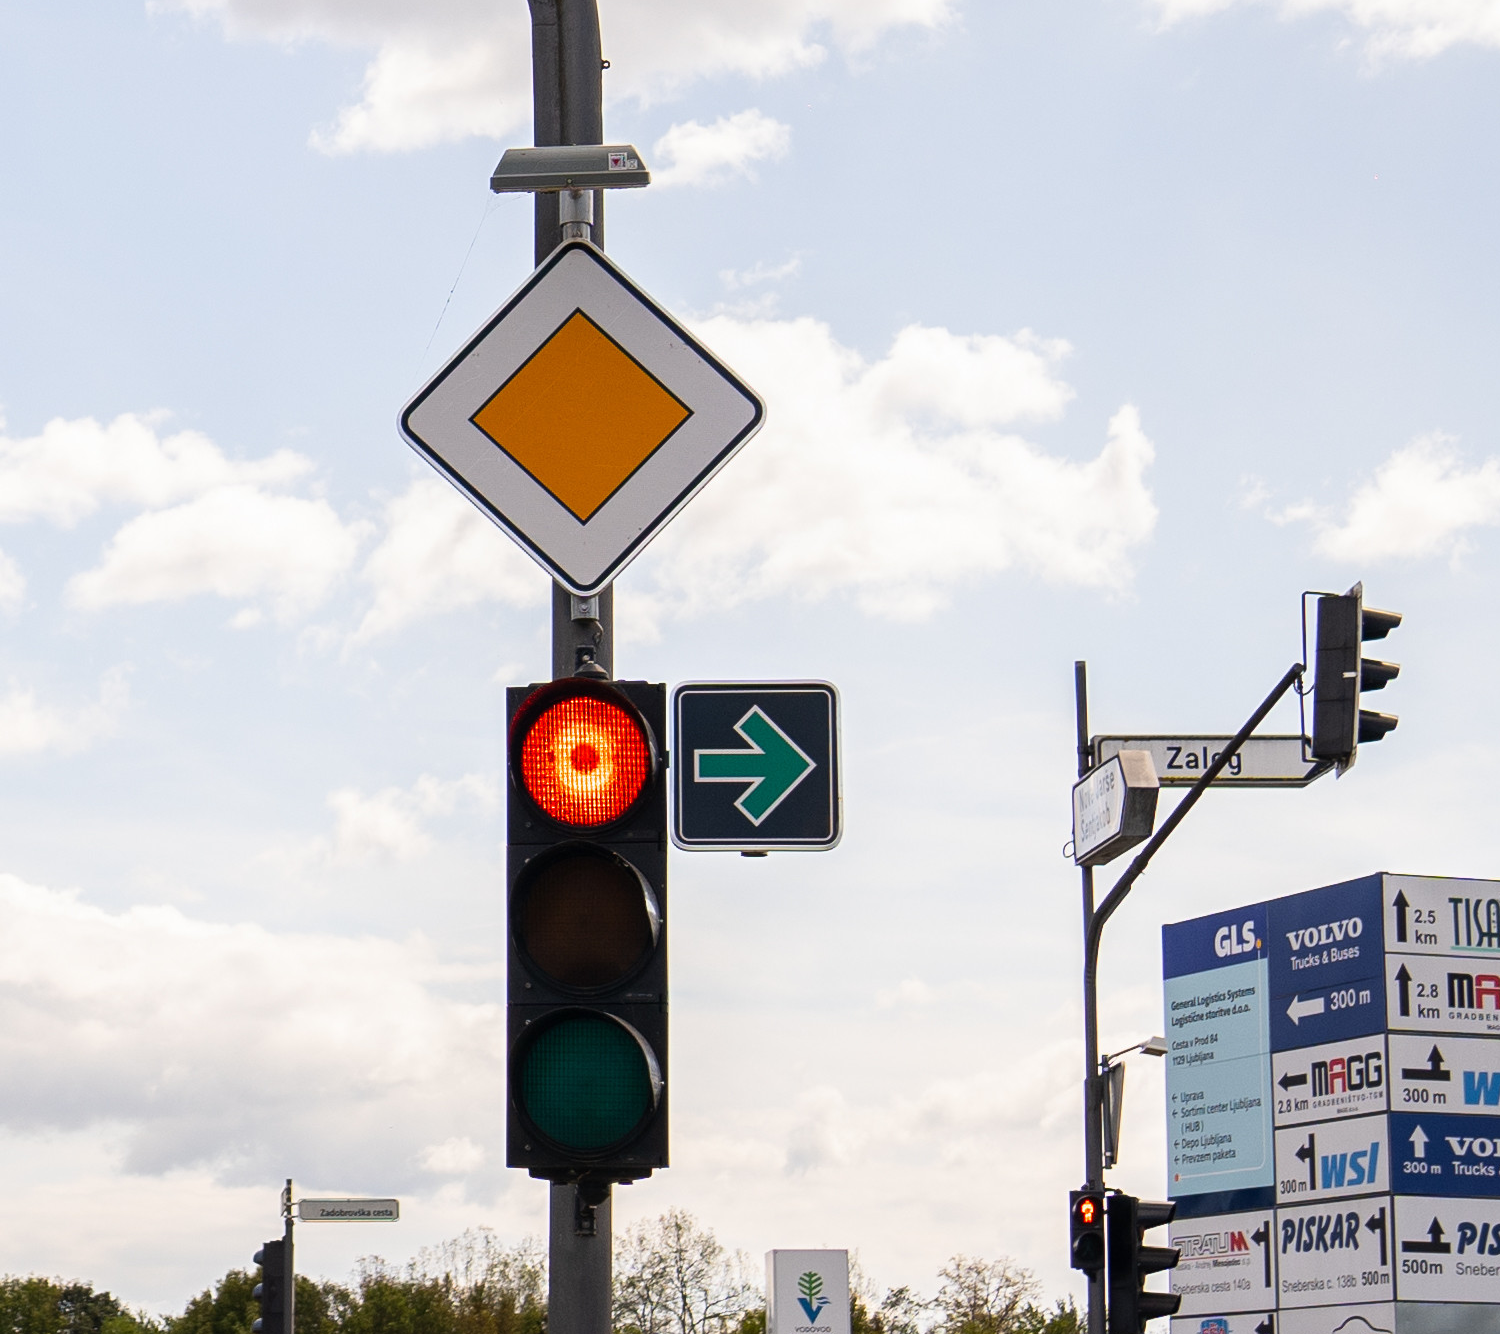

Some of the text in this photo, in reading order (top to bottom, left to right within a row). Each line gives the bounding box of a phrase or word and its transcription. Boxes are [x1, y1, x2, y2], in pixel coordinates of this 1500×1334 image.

[1414, 909, 1436, 924] 2.5
[1285, 917, 1363, 951] VOLVO
[1415, 929, 1437, 945] km
[1290, 946, 1360, 970] Trucks & Buses
[1171, 986, 1256, 1011] General Logistics Systems
[1416, 983, 1439, 998] 2.8
[1330, 988, 1371, 1010] 300 m
[1205, 1007, 1231, 1020] storitve
[1417, 1003, 1440, 1019] km
[1311, 1051, 1383, 1097] MAGG
[1402, 1088, 1447, 1104] 300 m
[1278, 1098, 1309, 1114] 2.8 km
[1402, 1162, 1442, 1174] 300 m
[1451, 1161, 1495, 1176] Trucks
[1280, 1179, 1307, 1194] 300 m
[372, 1209, 393, 1217] cesta
[1281, 1211, 1361, 1255] PISKAR
[1401, 1259, 1443, 1275] 500m
[1211, 1280, 1231, 1293] cesta
[1281, 1278, 1325, 1293] Sneberska
[1361, 1271, 1379, 1286] 500
[1380, 1272, 1390, 1285] m
